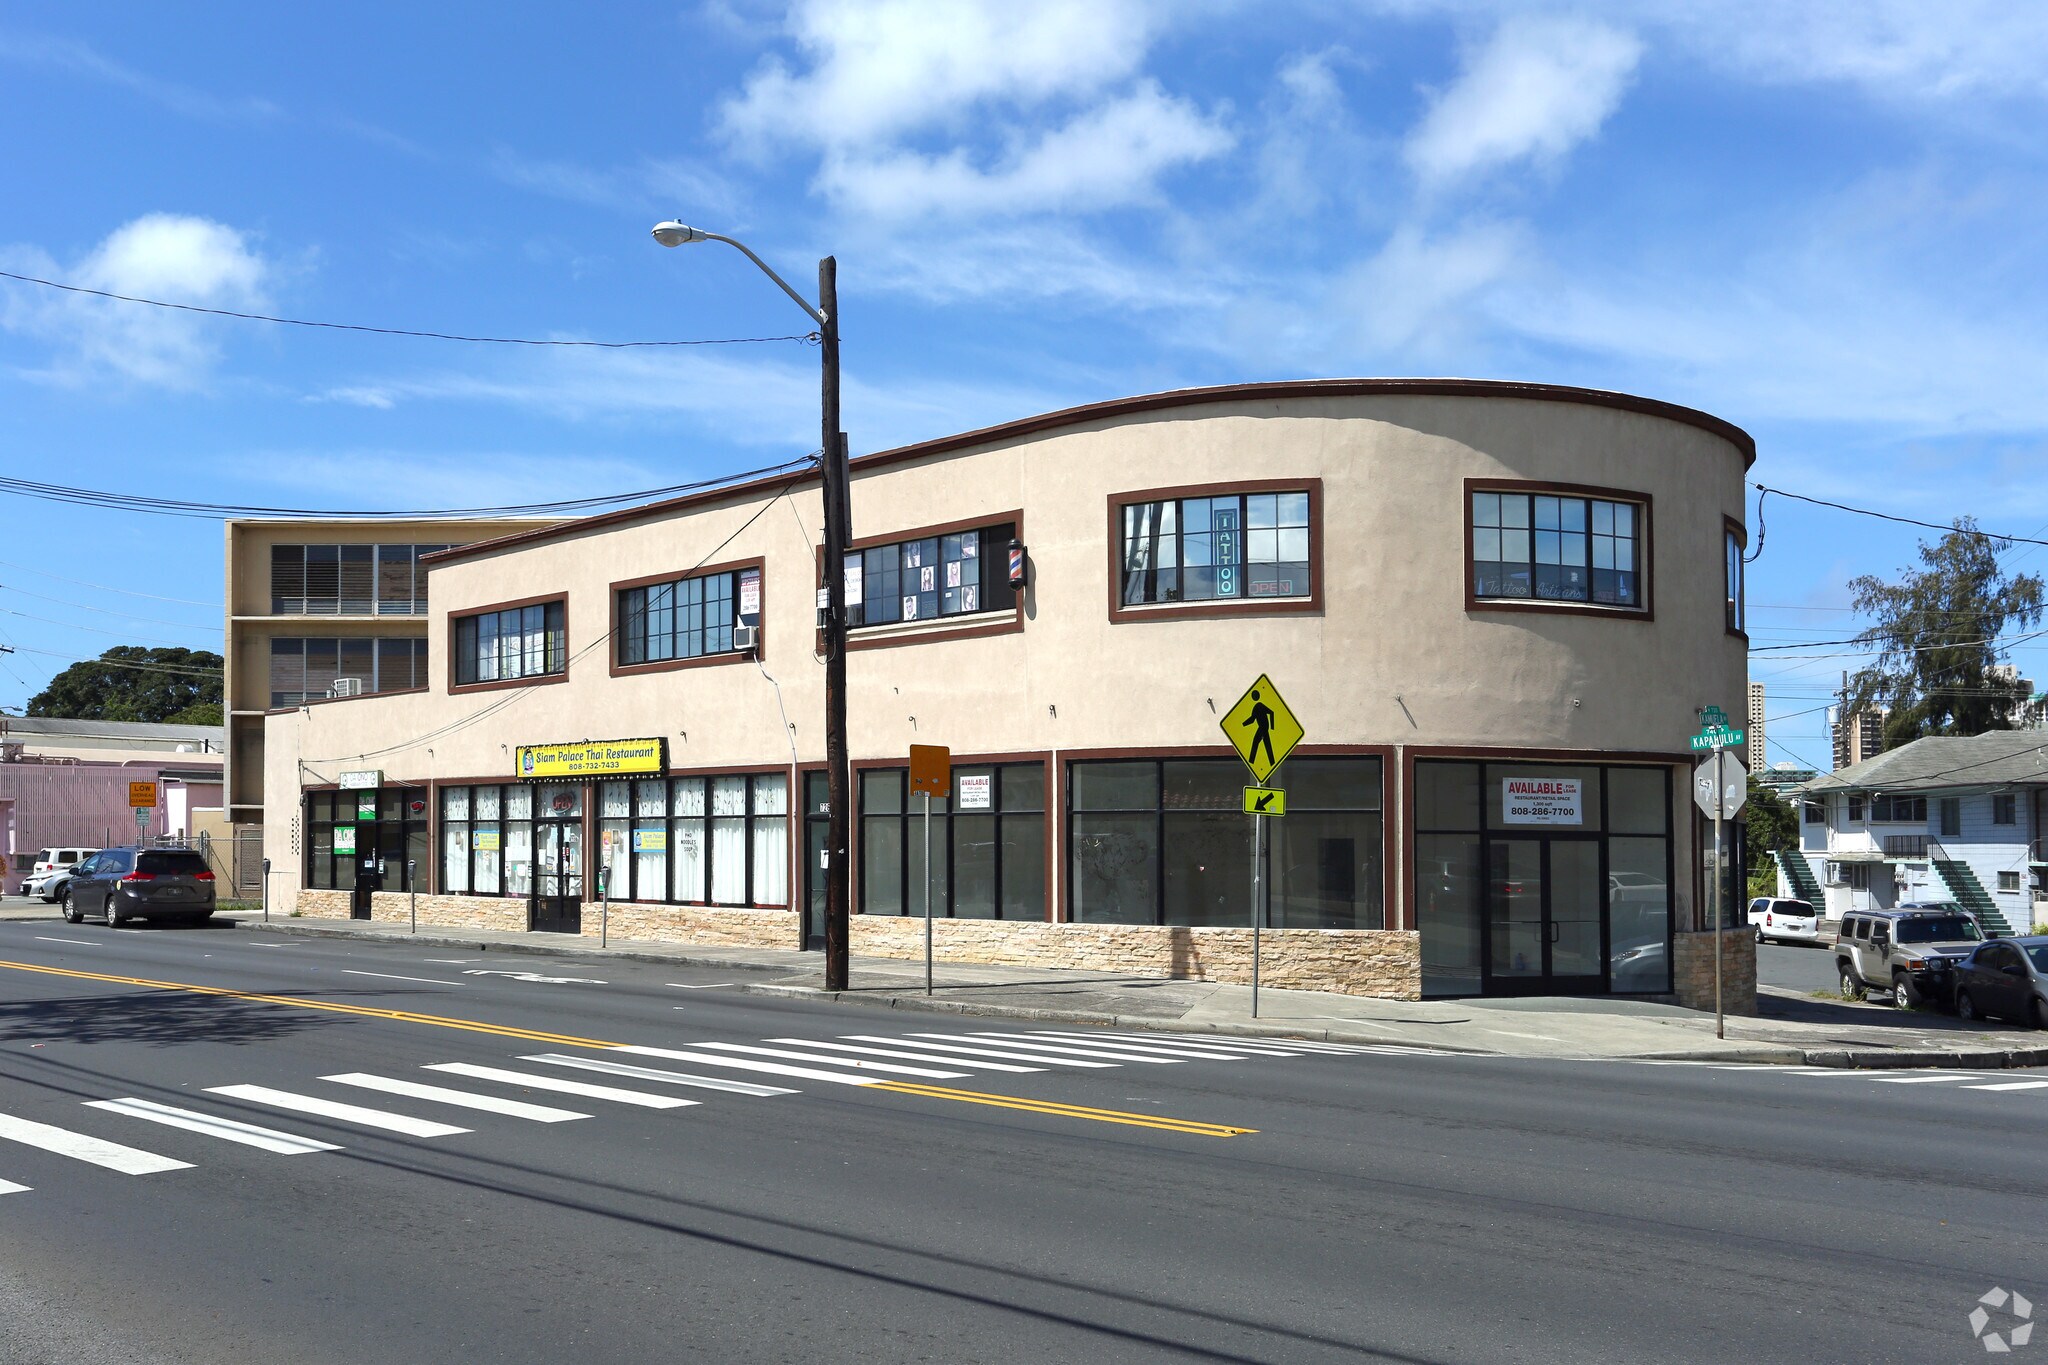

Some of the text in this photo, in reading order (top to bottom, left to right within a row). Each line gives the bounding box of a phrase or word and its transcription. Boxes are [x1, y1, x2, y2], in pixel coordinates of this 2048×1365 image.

[1220, 514, 1231, 593] TATTOO
[1248, 583, 1290, 595] OPEN
[1485, 580, 1527, 595] Tattoo
[1693, 733, 1734, 748] KAPAHULU
[536, 747, 654, 763] Siam Palace Thai Restaurant
[568, 761, 620, 771] 808-732-7433
[1508, 782, 1563, 794] AVAILABLE
[1511, 807, 1575, 816] 808-286-7700
